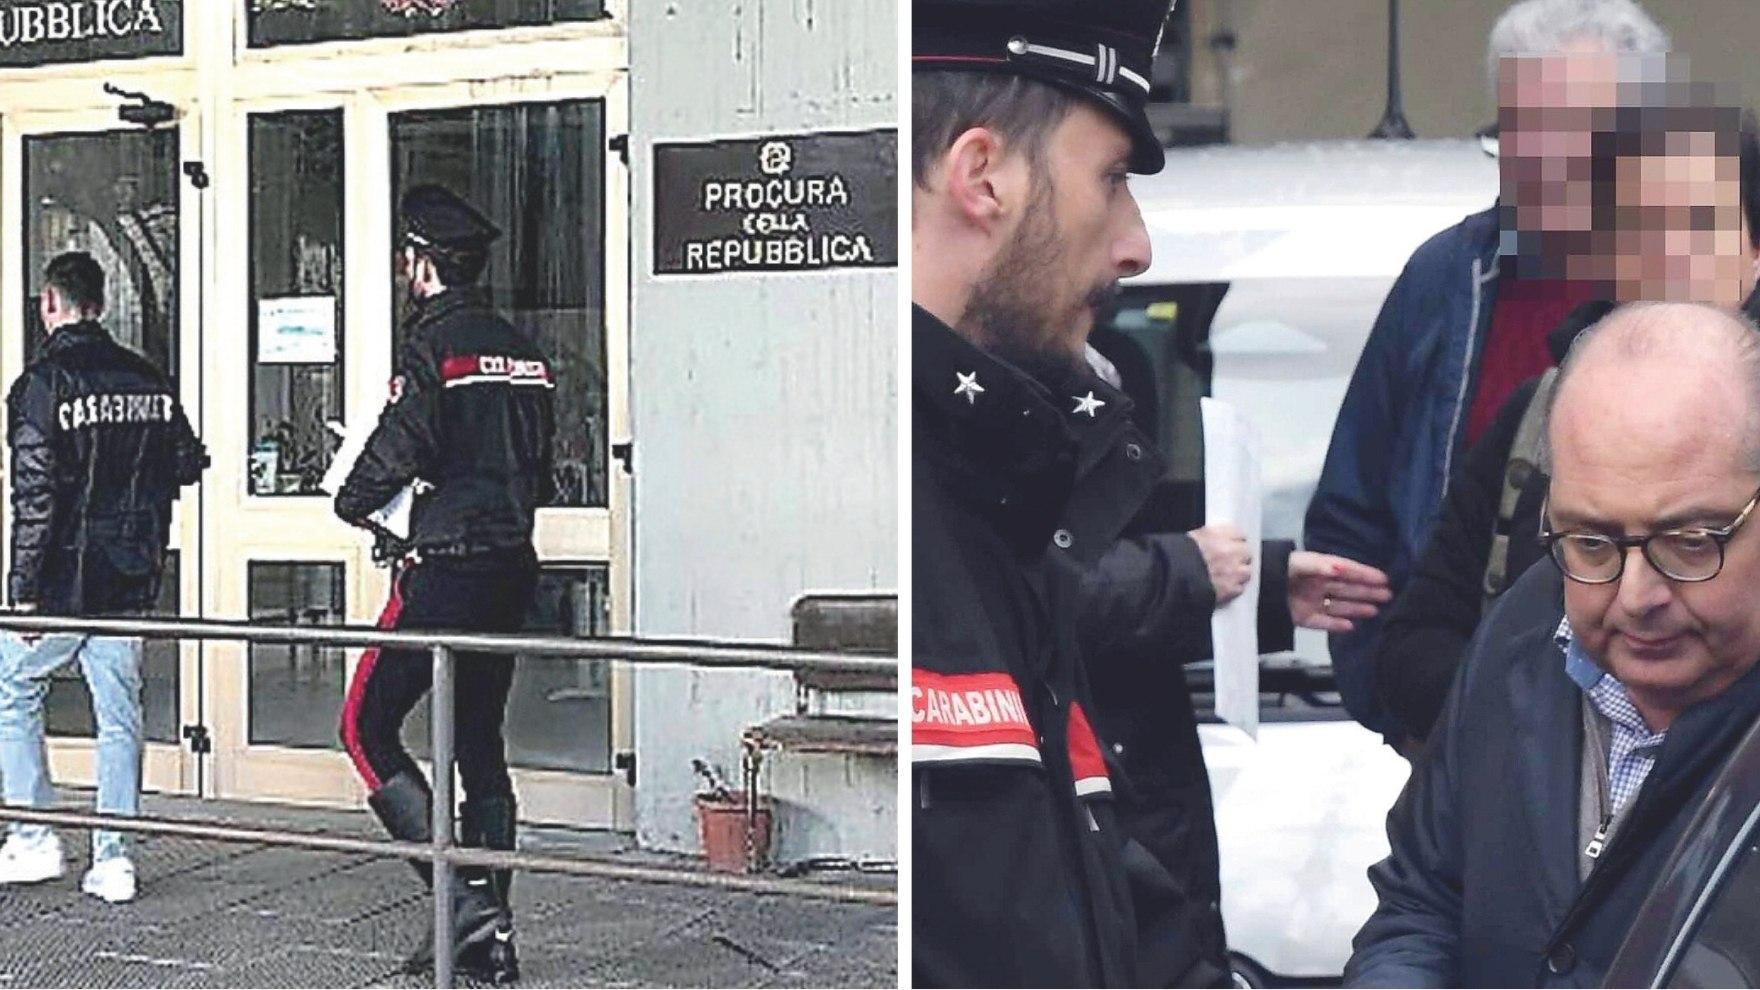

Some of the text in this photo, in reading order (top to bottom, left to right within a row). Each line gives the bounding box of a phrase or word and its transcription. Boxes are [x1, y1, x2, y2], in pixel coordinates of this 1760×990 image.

[704, 175, 848, 211] PROCURA
[686, 235, 874, 270] REPUBBLICA
[911, 686, 1029, 726] CARABINI
